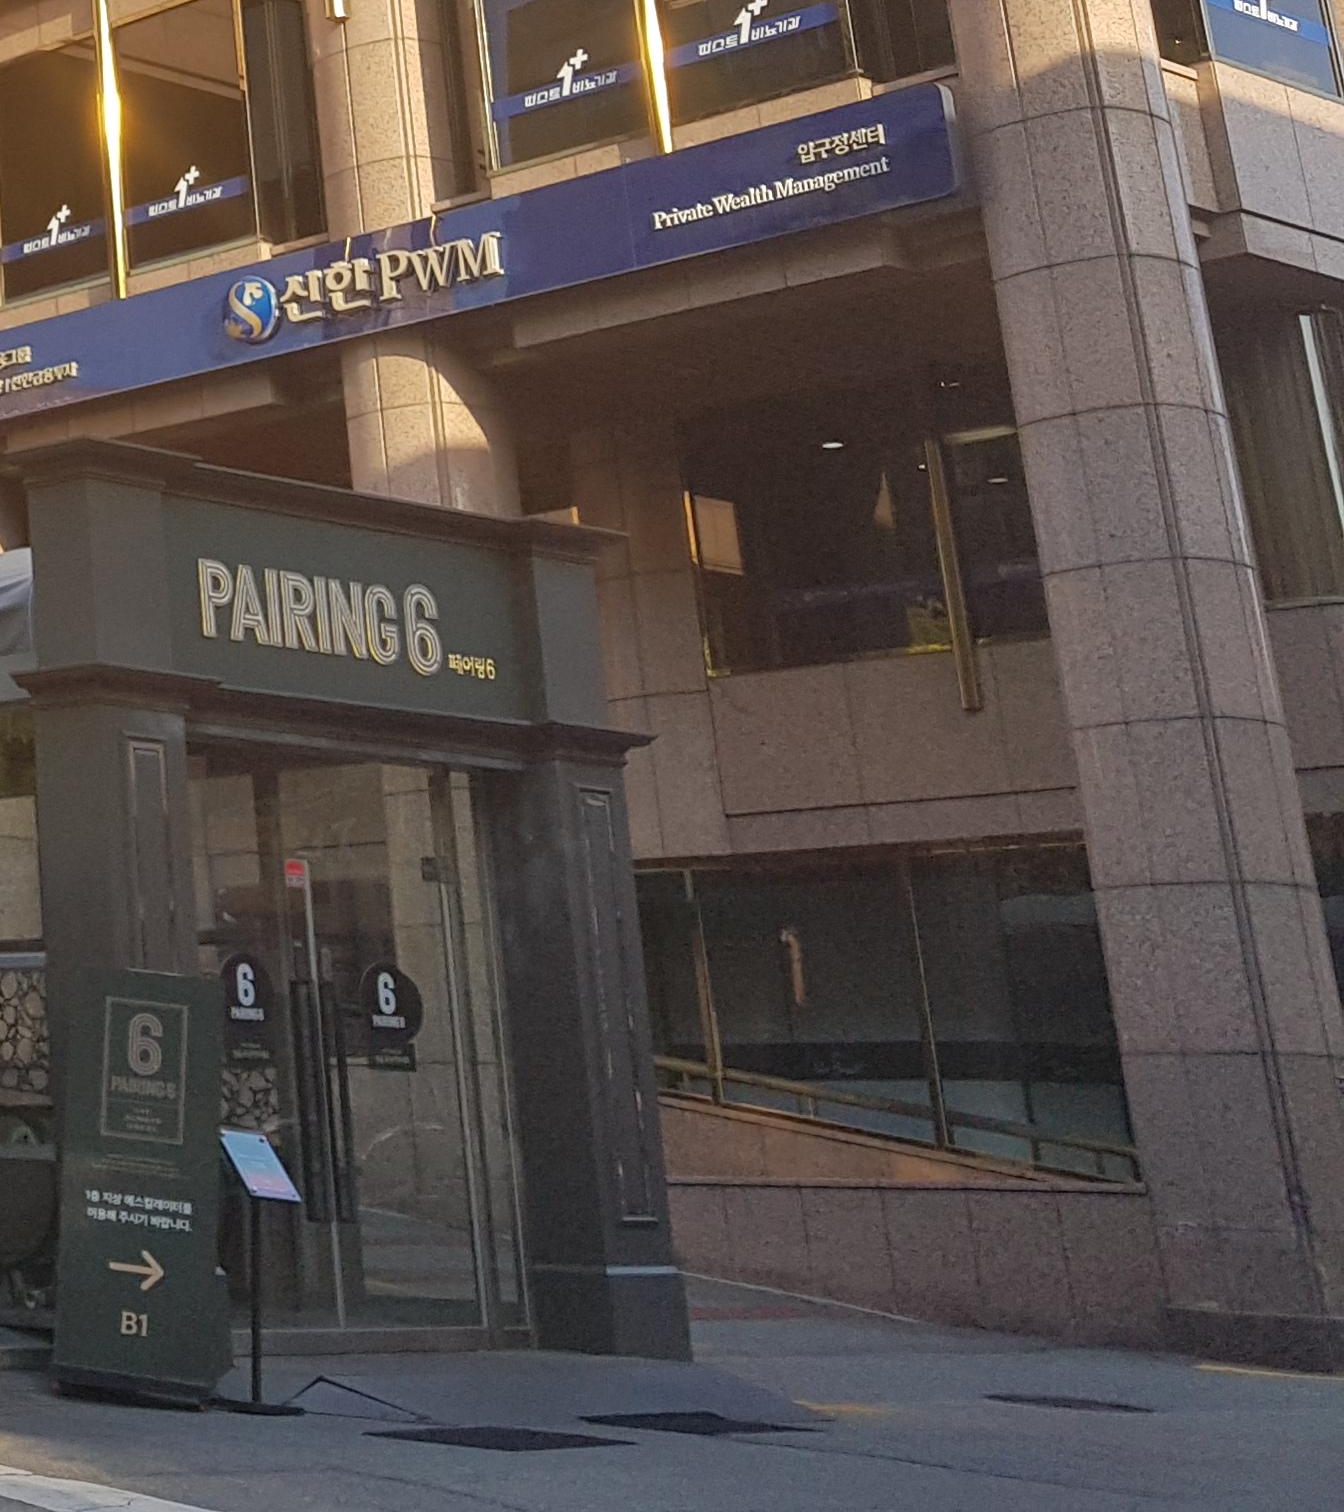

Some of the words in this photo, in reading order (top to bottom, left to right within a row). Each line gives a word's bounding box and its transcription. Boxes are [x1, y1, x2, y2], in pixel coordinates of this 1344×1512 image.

[797, 123, 887, 164] 압구정센터
[652, 202, 714, 230] Private
[712, 184, 774, 215] Wealth
[773, 156, 891, 199] Management
[197, 557, 400, 666] PAIRING
[403, 583, 444, 677] 6
[448, 652, 497, 681] 페어링6
[236, 962, 256, 1007] 6
[377, 971, 397, 1015] 6
[127, 1012, 163, 1076] 6
[118, 1210, 148, 1227] 주시기
[119, 1311, 149, 1337] B1
